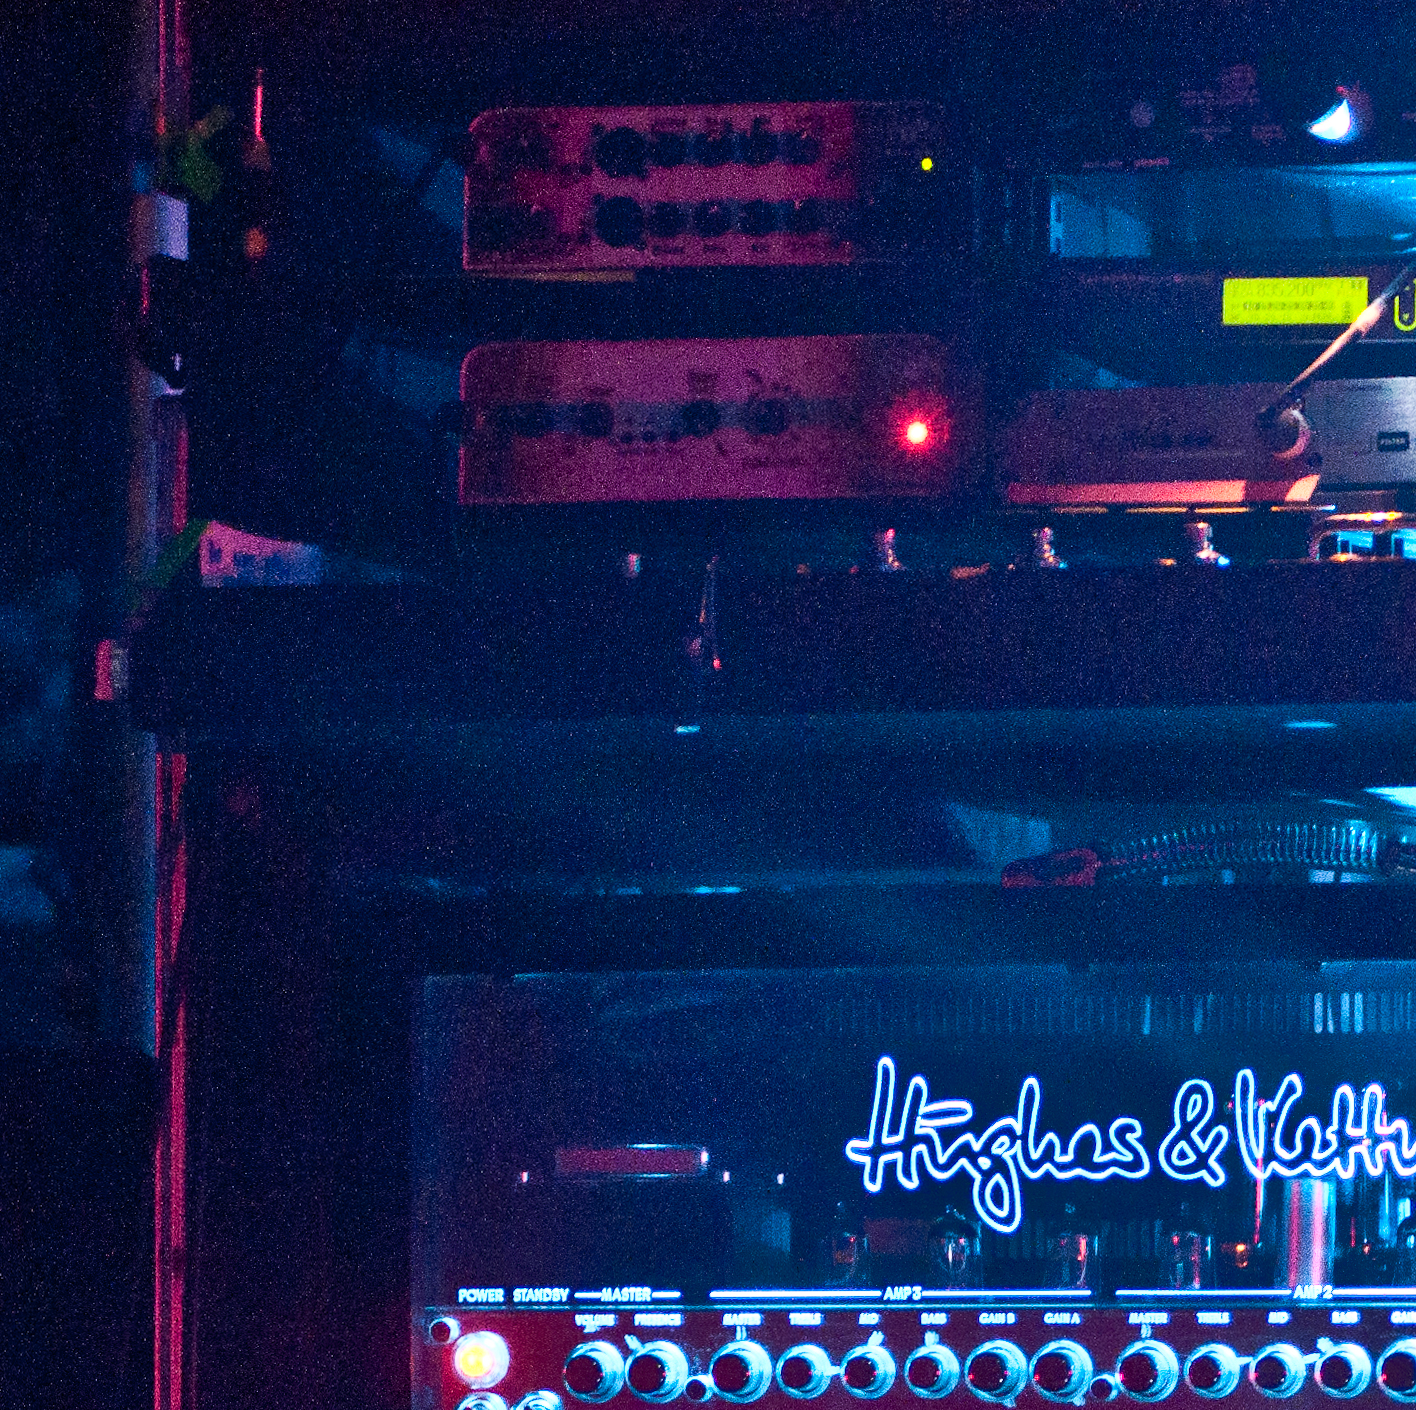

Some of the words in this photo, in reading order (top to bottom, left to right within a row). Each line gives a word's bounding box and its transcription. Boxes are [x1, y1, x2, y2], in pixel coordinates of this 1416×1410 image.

[845, 1057, 1149, 1234] Hughes
[1159, 1079, 1228, 1187] &
[458, 1288, 504, 1302] POWER
[513, 1288, 569, 1302] STANDBY
[601, 1287, 651, 1301] MASTER
[884, 1286, 911, 1300] AMP
[912, 1286, 922, 1300] 3
[1293, 1285, 1321, 1299] AMP
[1322, 1285, 1333, 1299] 2
